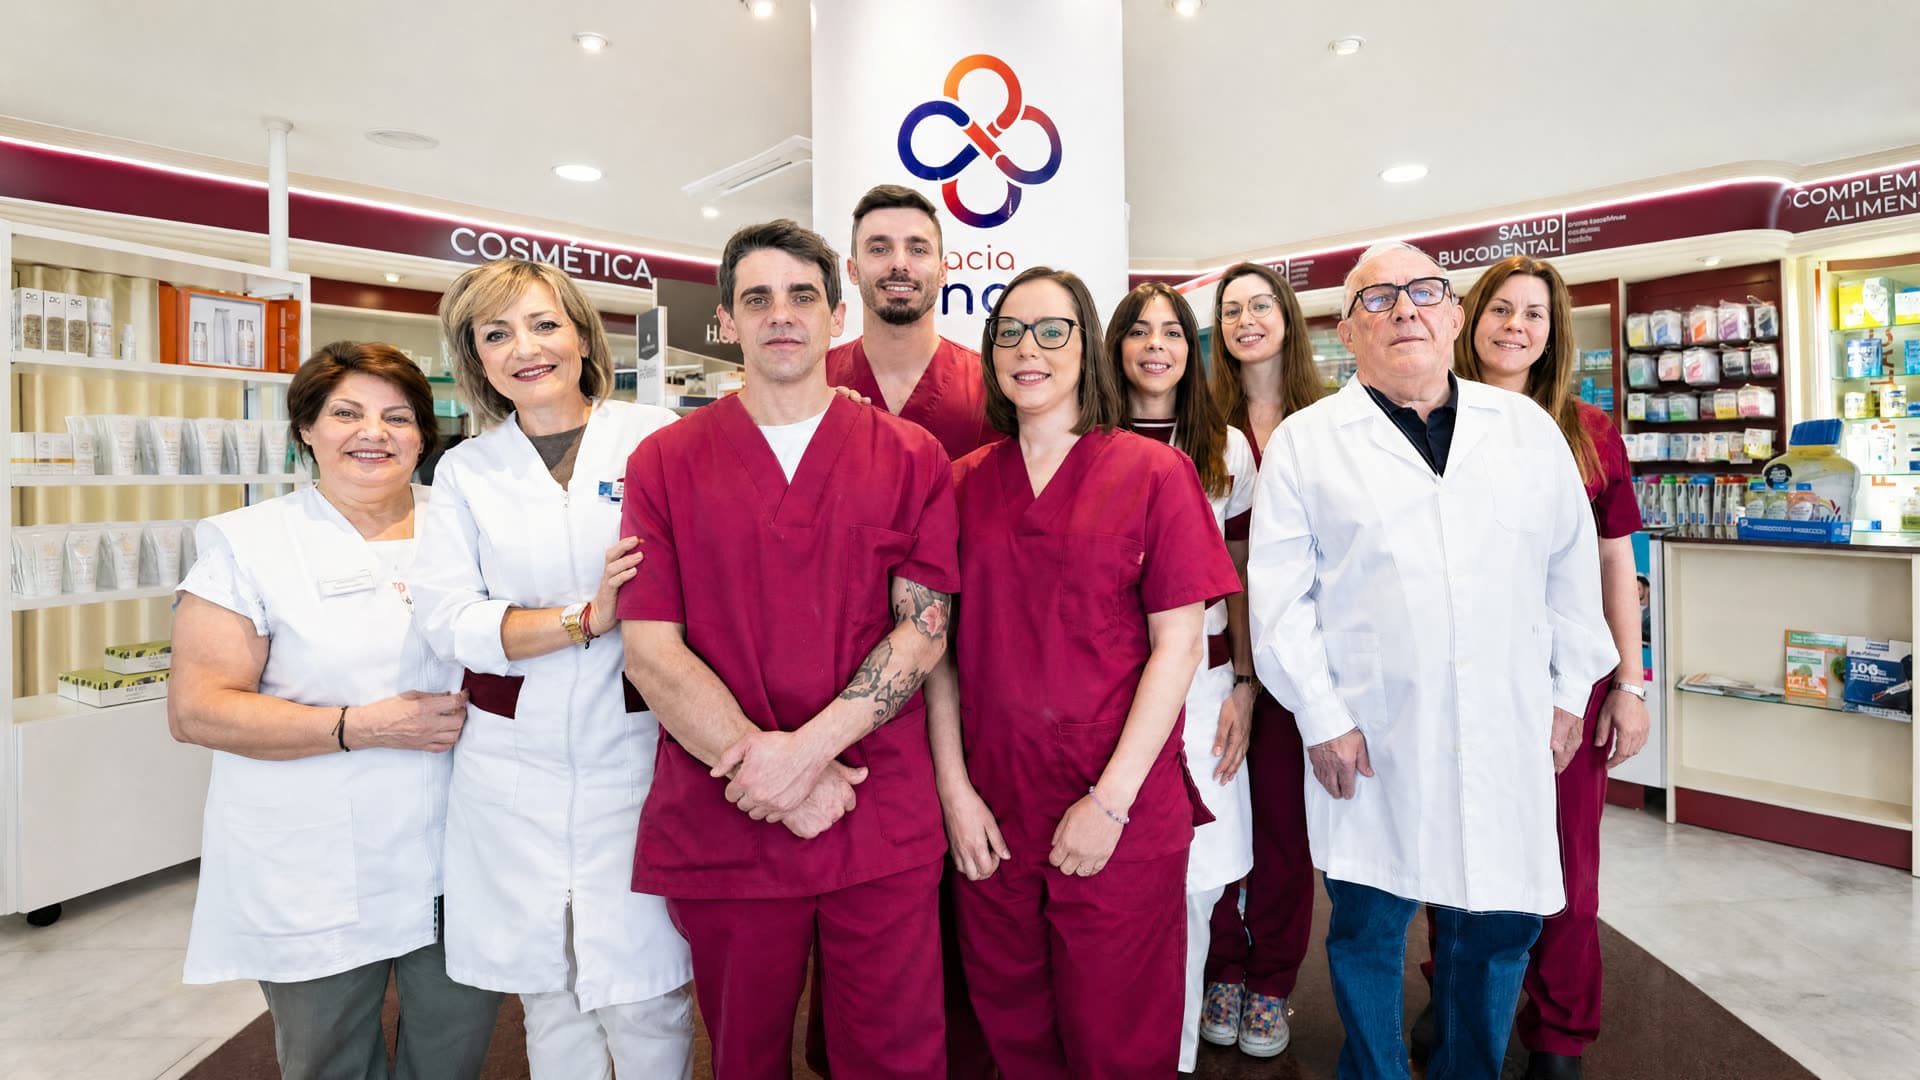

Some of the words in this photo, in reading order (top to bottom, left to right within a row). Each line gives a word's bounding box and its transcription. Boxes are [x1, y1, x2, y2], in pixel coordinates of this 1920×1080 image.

[1793, 170, 1920, 209] COMPLEM
[1824, 192, 1920, 223] ALIMEN
[1498, 218, 1560, 241] SALUD
[450, 227, 655, 285] COSMÉTICA
[1438, 237, 1560, 266] BUCODENTAL
